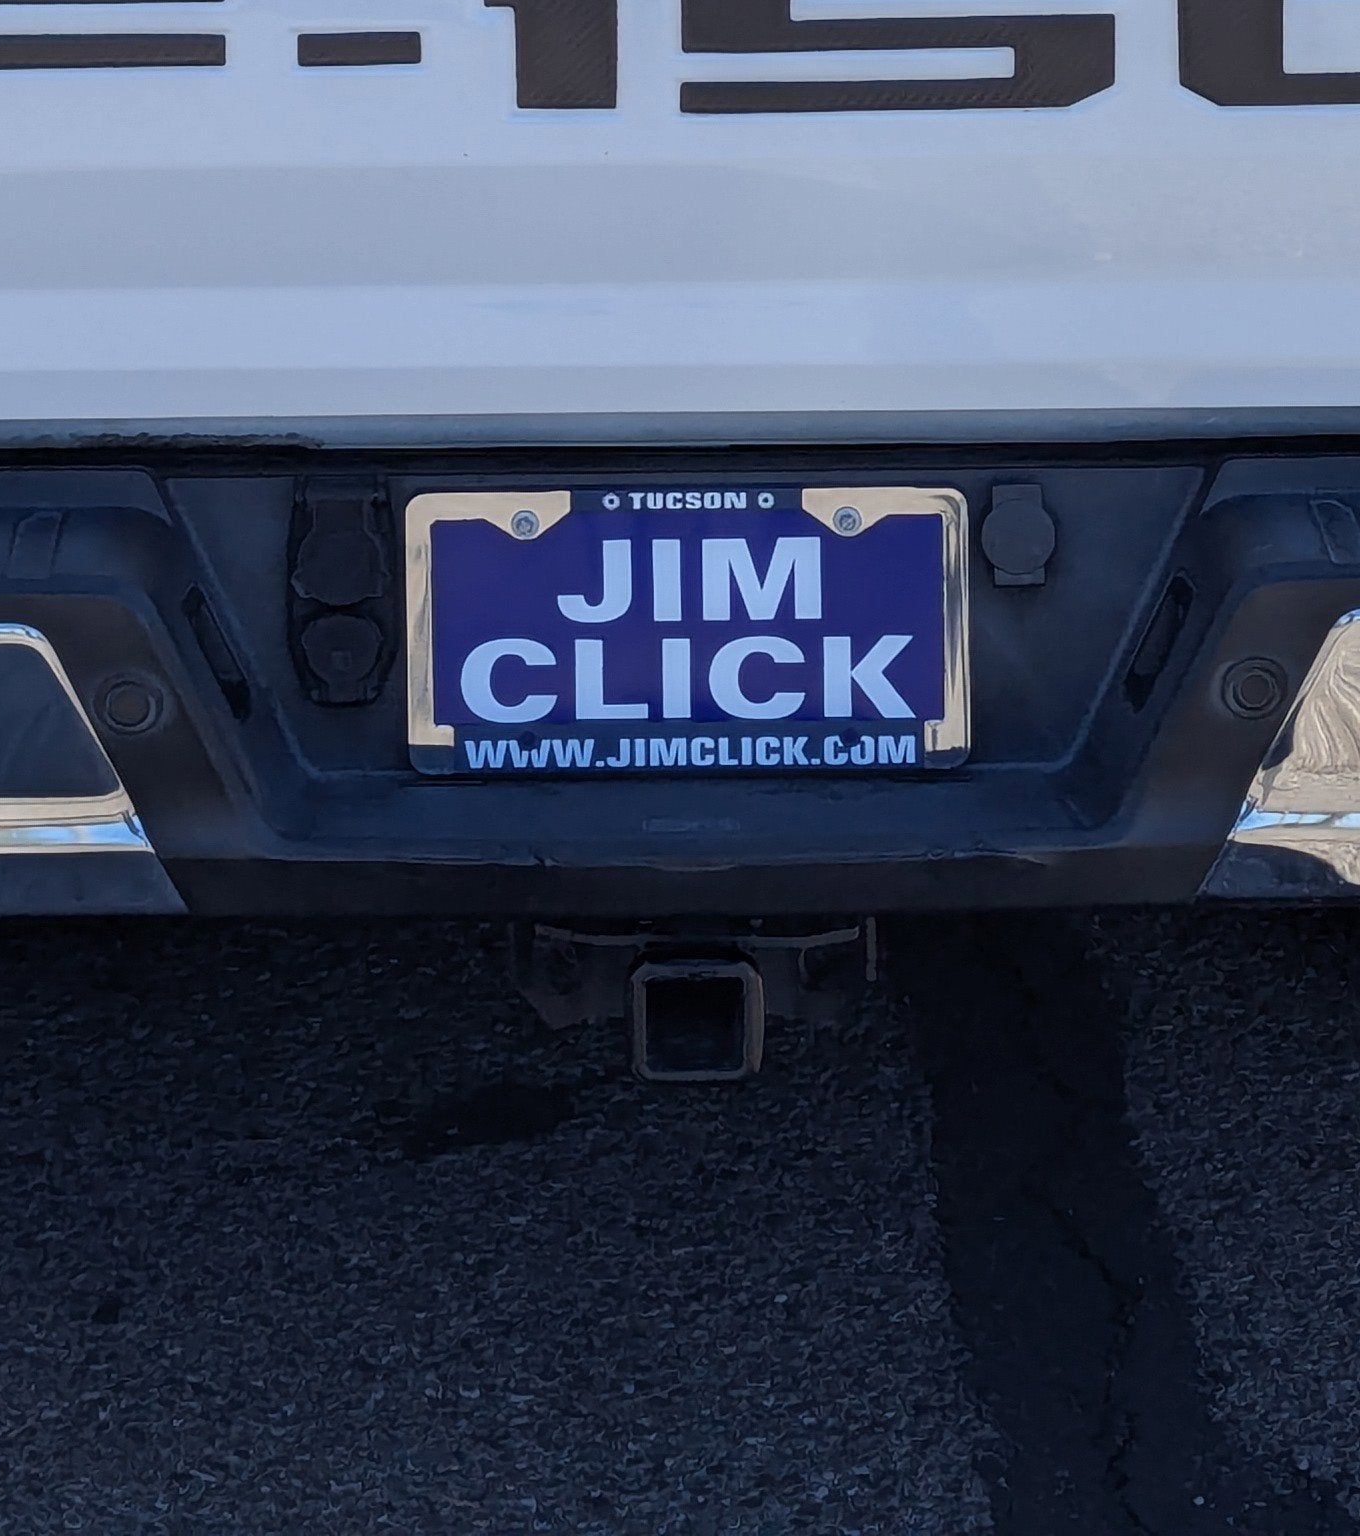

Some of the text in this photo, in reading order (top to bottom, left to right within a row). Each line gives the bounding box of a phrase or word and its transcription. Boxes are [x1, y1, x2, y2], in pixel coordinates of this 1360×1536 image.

[628, 492, 748, 511] TUCSON
[557, 536, 822, 623] JIM
[460, 635, 916, 723] CLICK
[464, 734, 917, 769] WWW.JIMCLICK.COM
